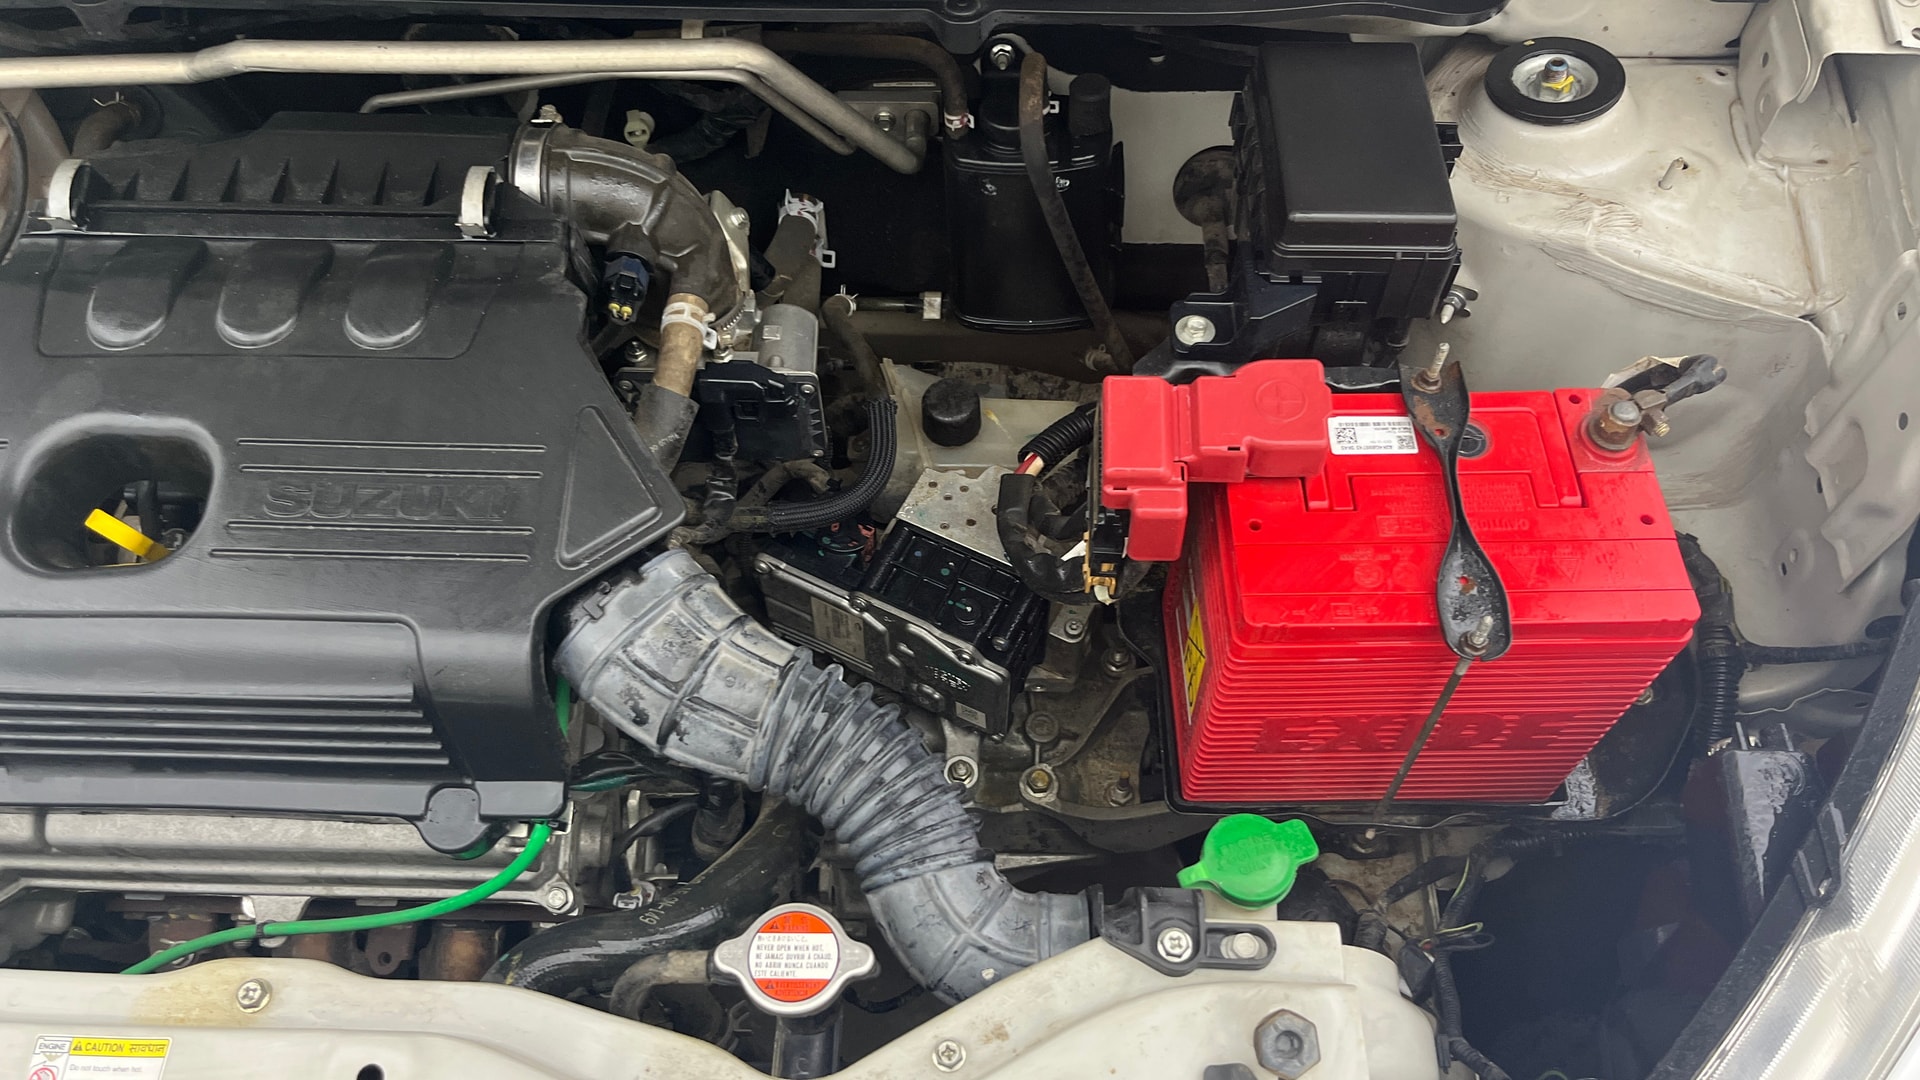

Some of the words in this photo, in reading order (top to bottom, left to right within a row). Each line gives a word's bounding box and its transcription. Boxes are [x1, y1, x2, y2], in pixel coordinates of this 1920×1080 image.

[262, 482, 510, 521] SUZUKI
[1254, 712, 1582, 753] EXIDE
[777, 944, 791, 952] OPEN
[38, 1042, 67, 1051] ENGINE
[85, 1042, 125, 1053] CAUTION
[69, 1063, 79, 1072] Do
[80, 1064, 92, 1072] not
[93, 1064, 111, 1073] touch
[112, 1064, 130, 1073] when
